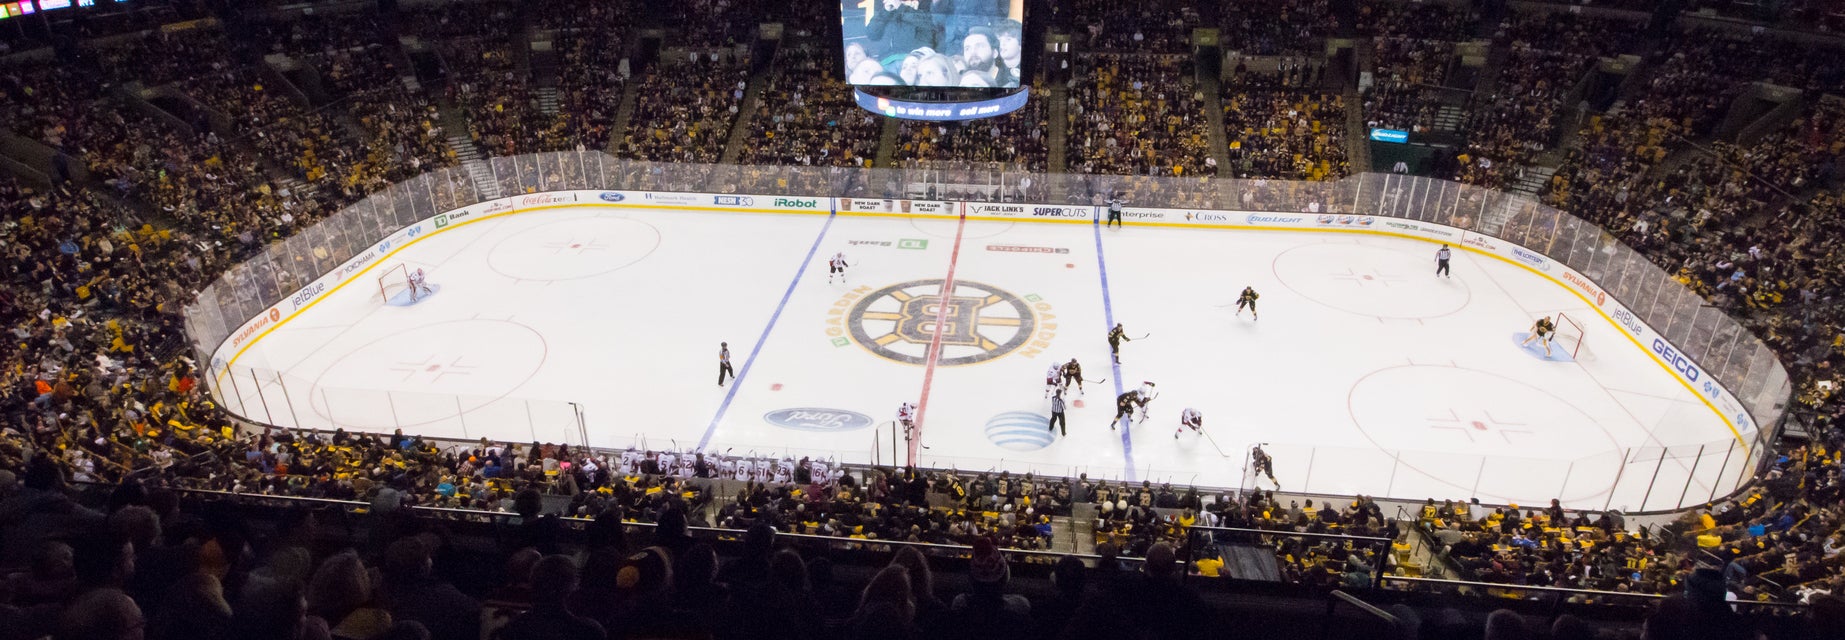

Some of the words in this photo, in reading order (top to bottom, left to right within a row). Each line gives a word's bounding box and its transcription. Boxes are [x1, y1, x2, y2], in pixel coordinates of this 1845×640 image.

[908, 107, 924, 115] win
[774, 198, 817, 208] iRobot
[1033, 207, 1087, 217] SUPERCUTS
[1119, 211, 1164, 219] nterprise
[344, 251, 376, 273] YOKOHAMA
[1563, 271, 1598, 297] SYLVANIA
[292, 282, 325, 311] jetBlue
[1611, 308, 1642, 336] jetBlue
[233, 316, 269, 348] SYLVANIA
[1652, 338, 1699, 382] GEICO
[623, 456, 629, 466] 2
[738, 466, 745, 476] 6
